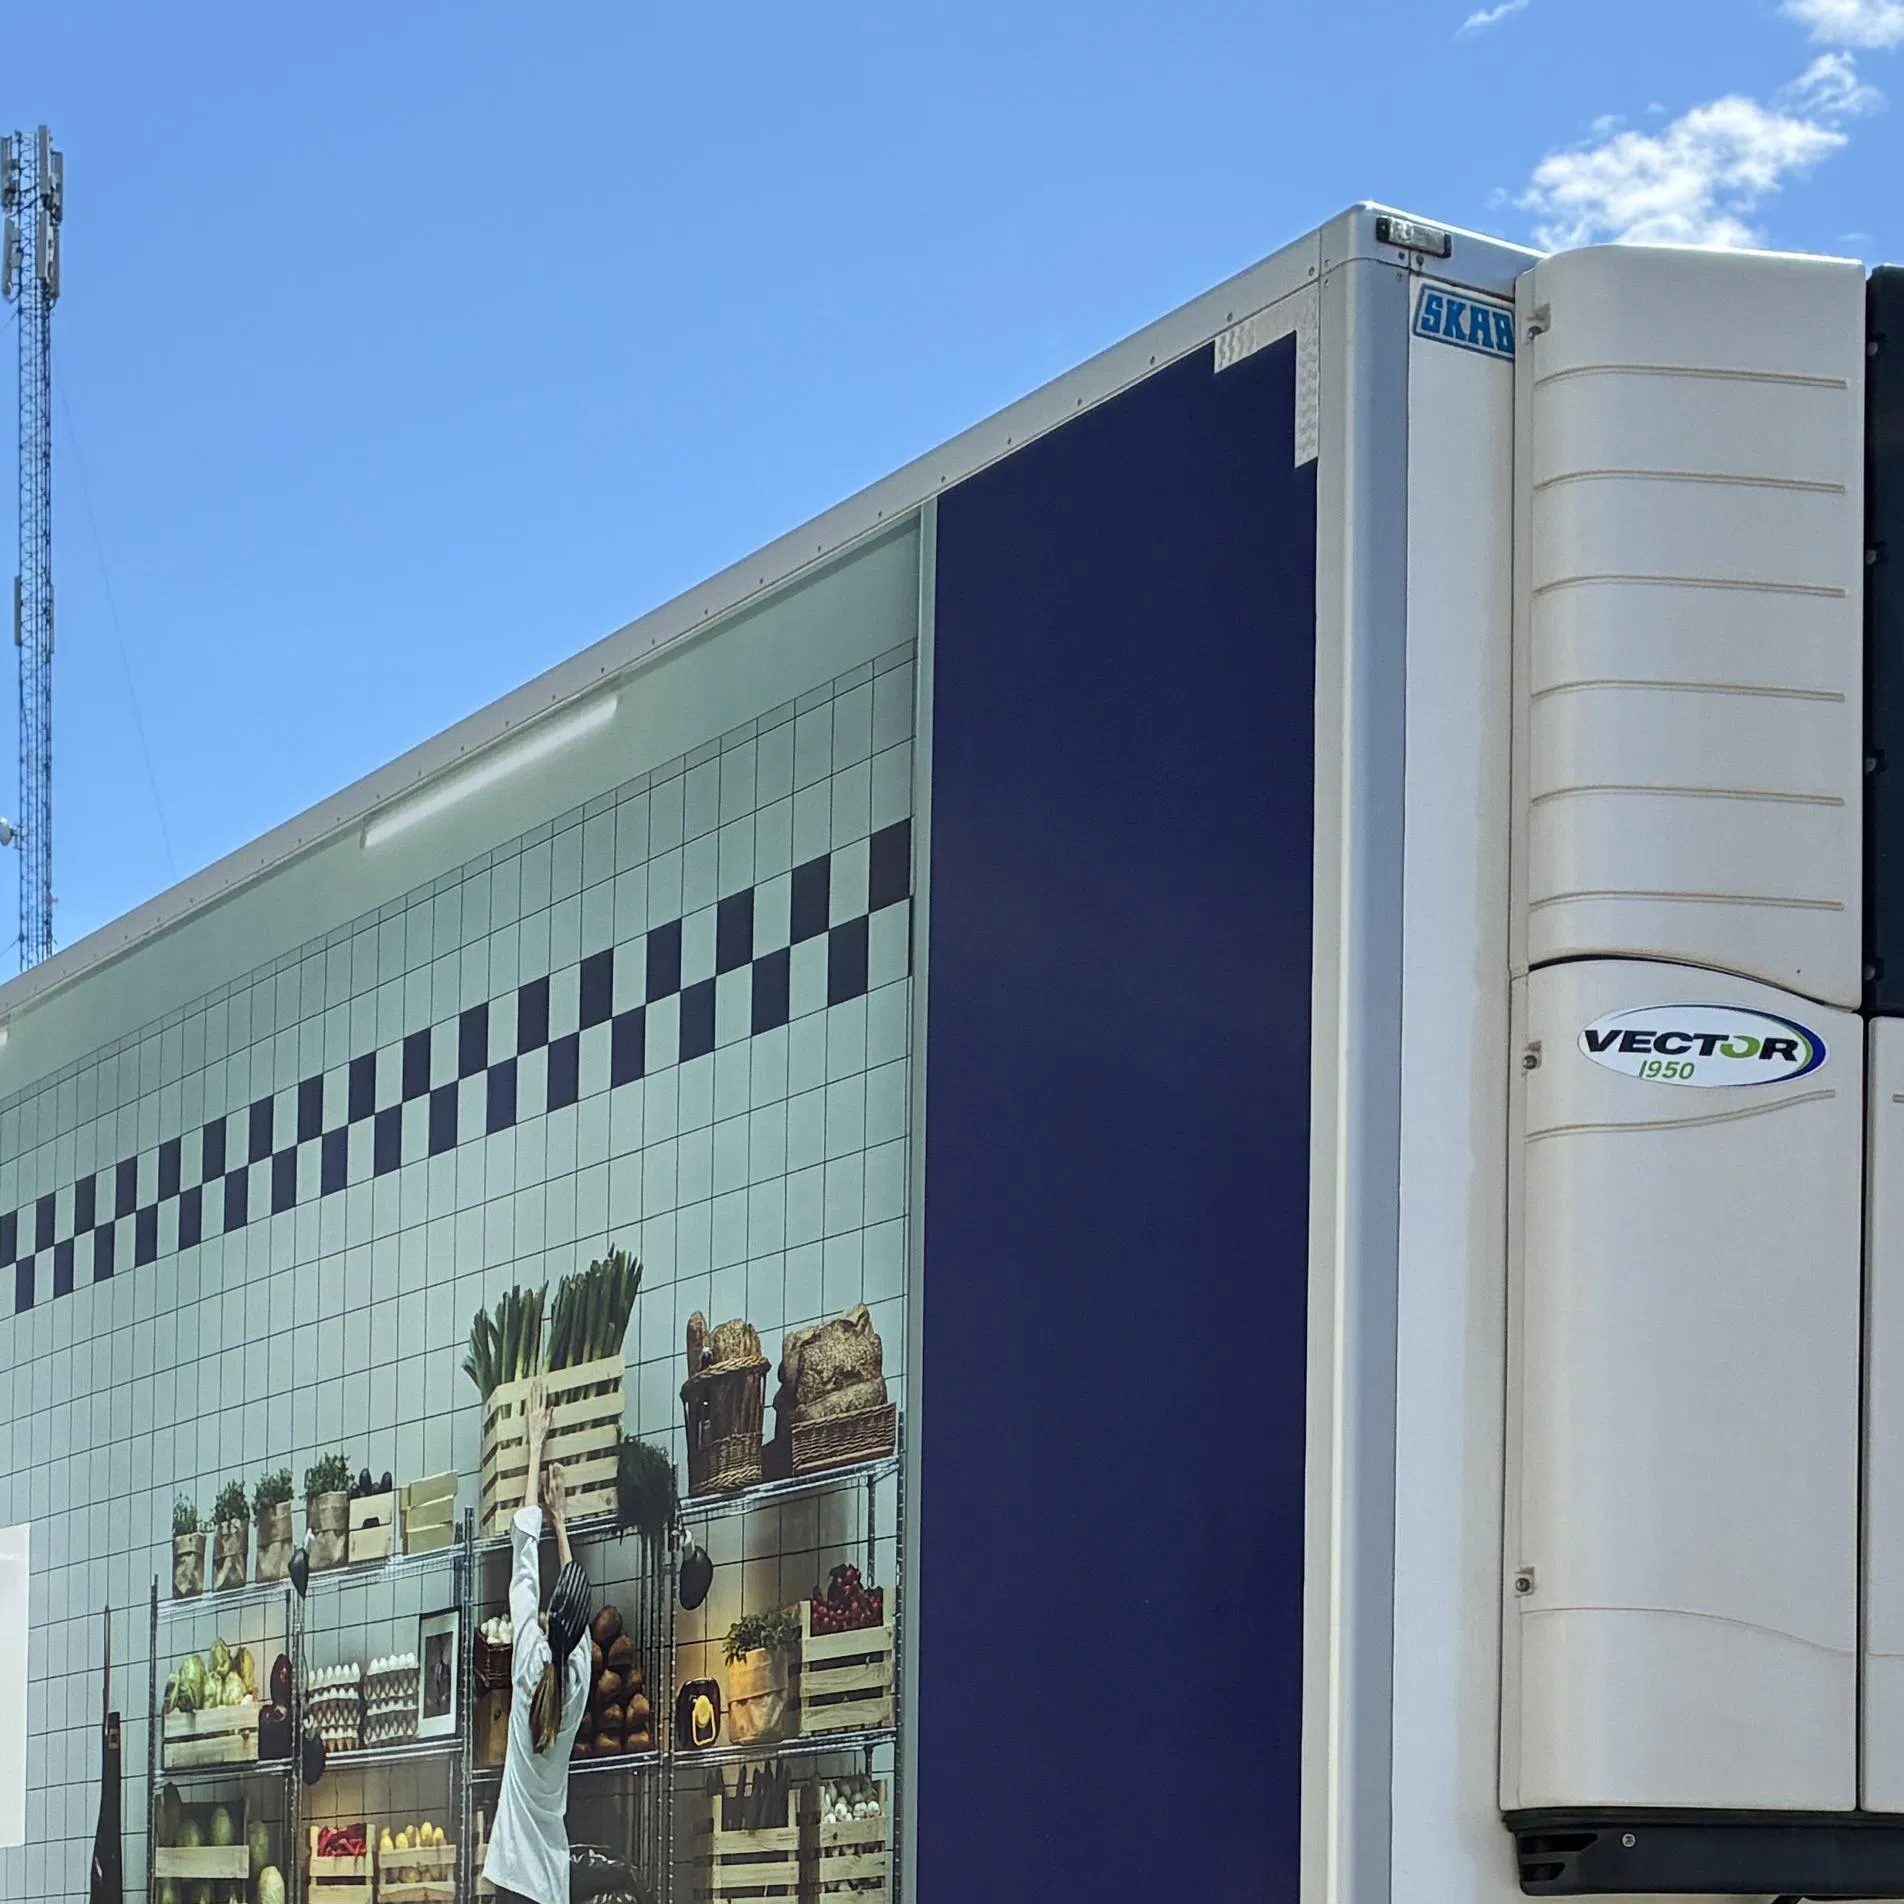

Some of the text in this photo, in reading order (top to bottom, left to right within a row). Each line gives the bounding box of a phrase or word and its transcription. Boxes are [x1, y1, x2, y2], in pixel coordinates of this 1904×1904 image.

[1421, 294, 1515, 353] SKAB
[1584, 1030, 1799, 1062] VECTOR
[1639, 1060, 1695, 1079] 1950
